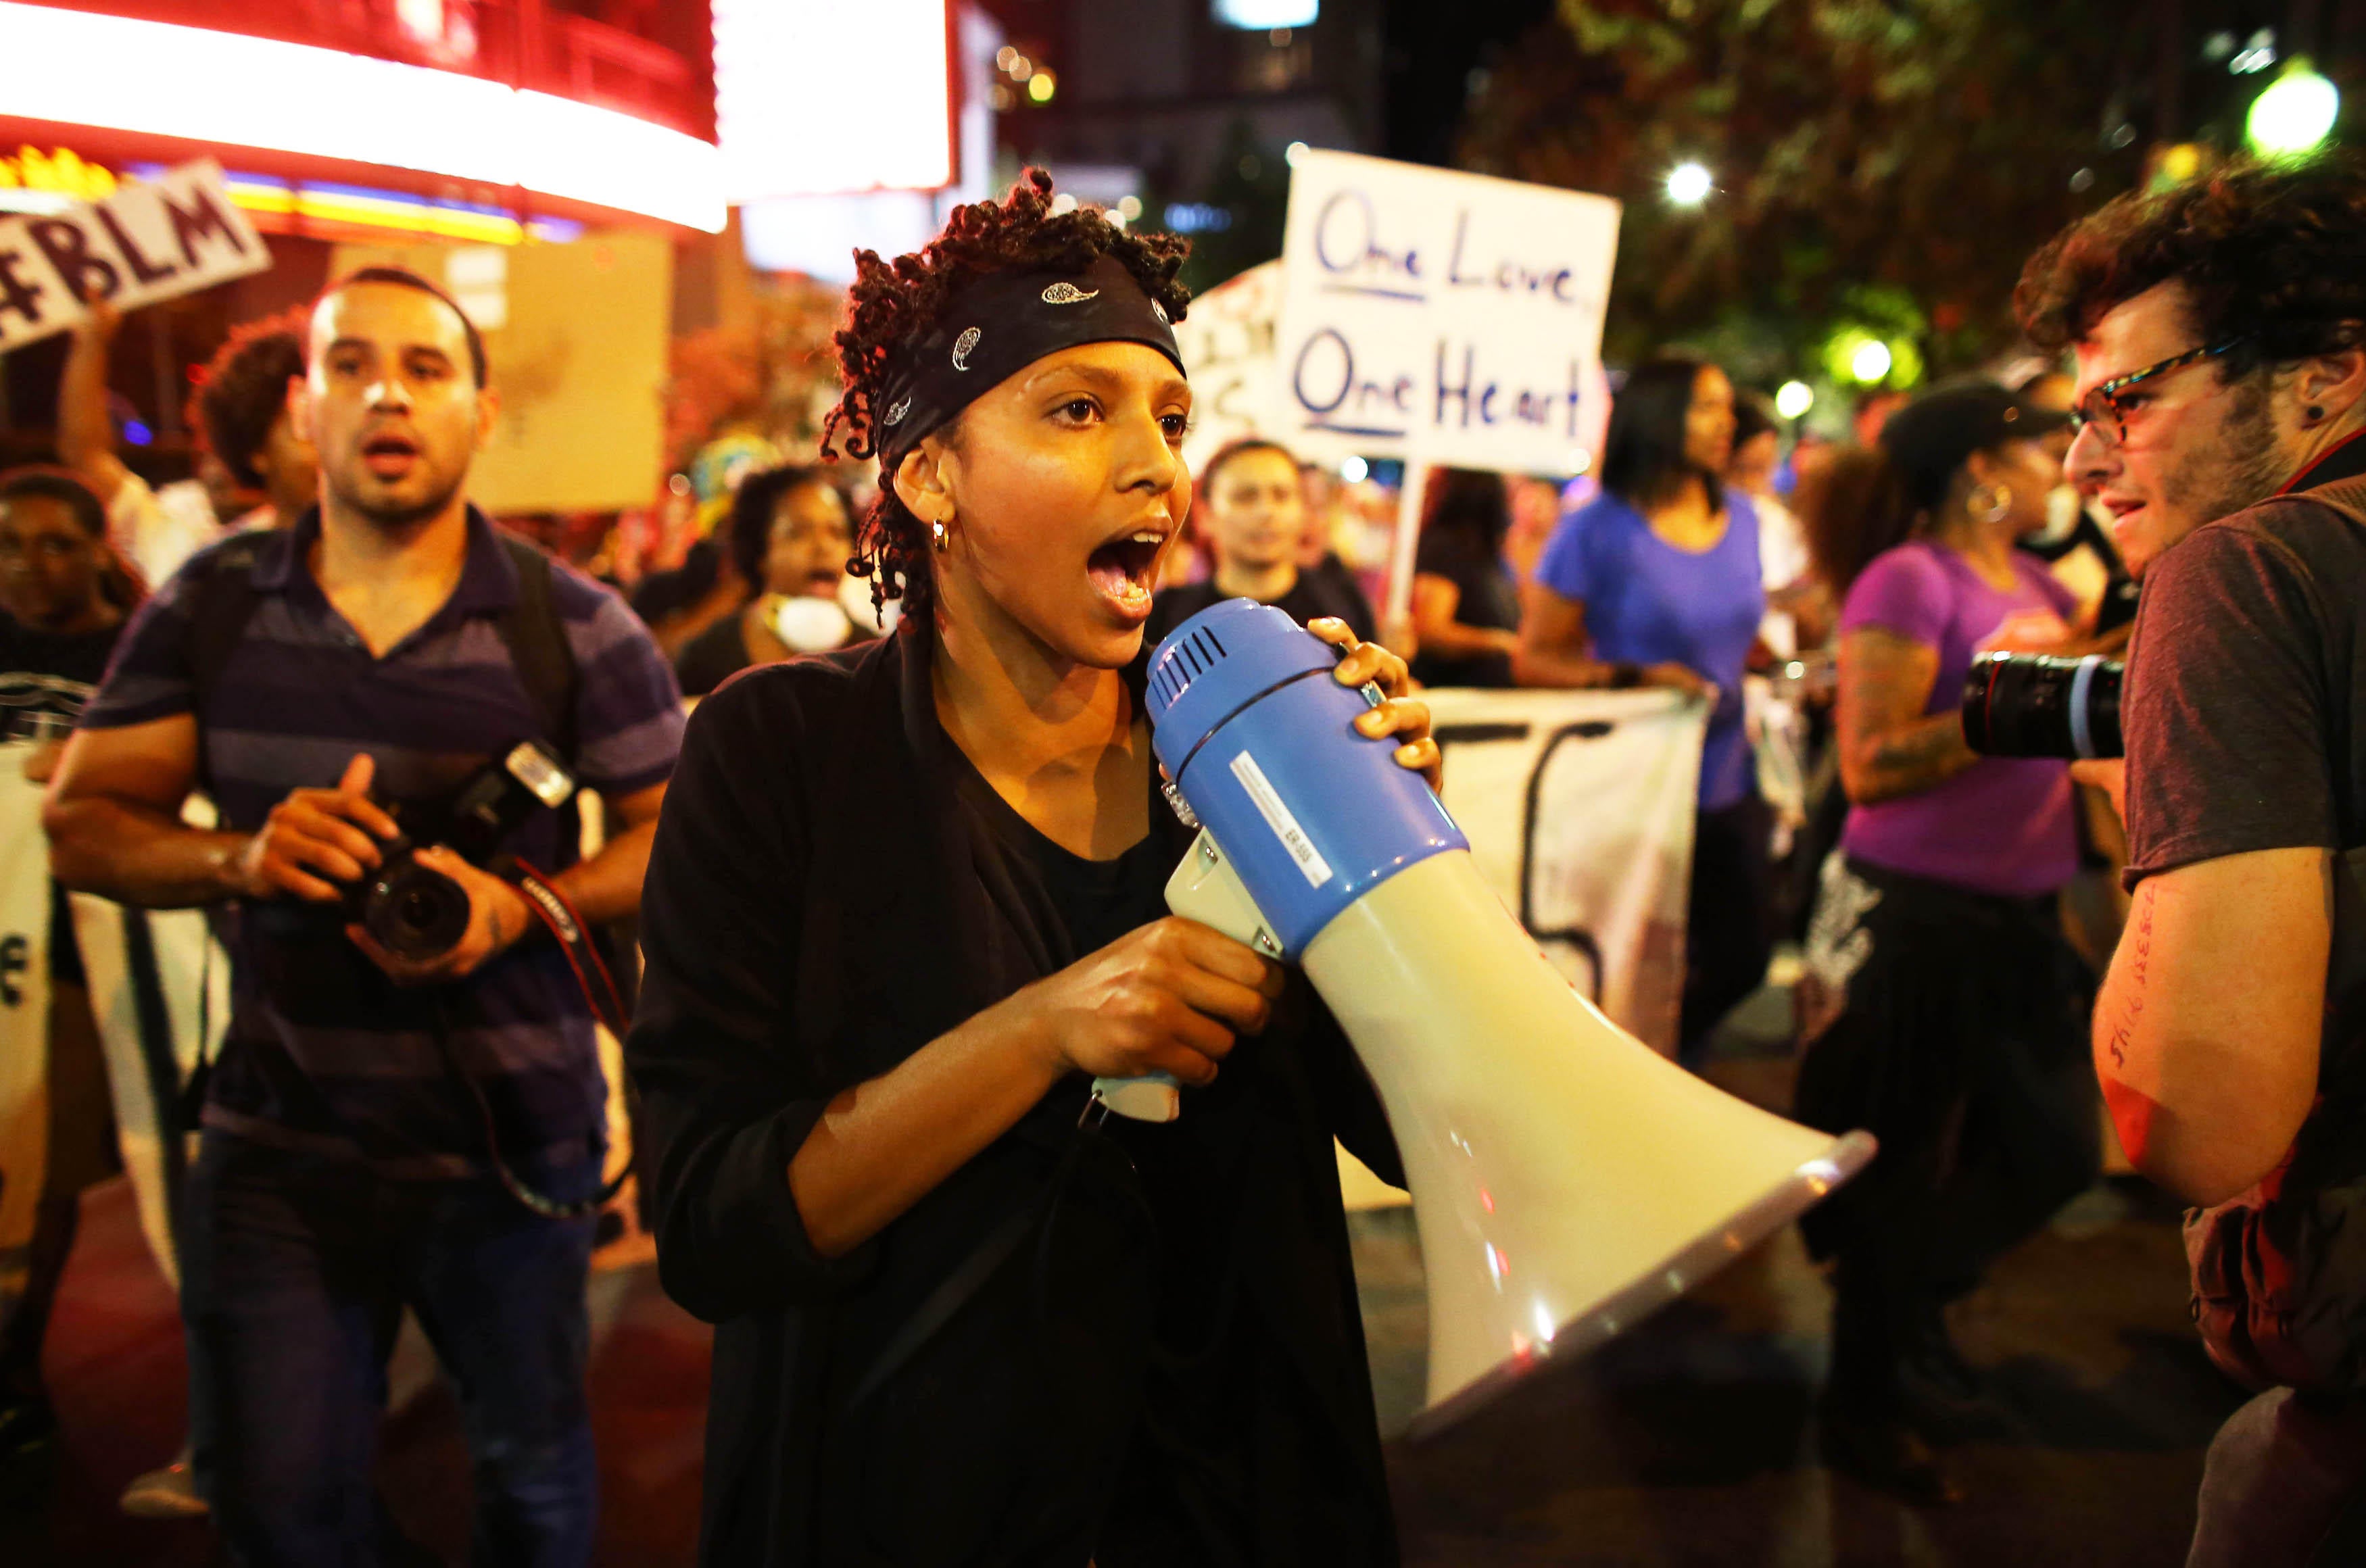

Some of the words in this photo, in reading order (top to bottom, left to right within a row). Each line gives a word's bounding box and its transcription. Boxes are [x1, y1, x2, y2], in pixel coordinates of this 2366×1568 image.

[1316, 189, 1421, 274] One
[1294, 328, 1410, 412] One
[1436, 338, 1579, 438] Heart
